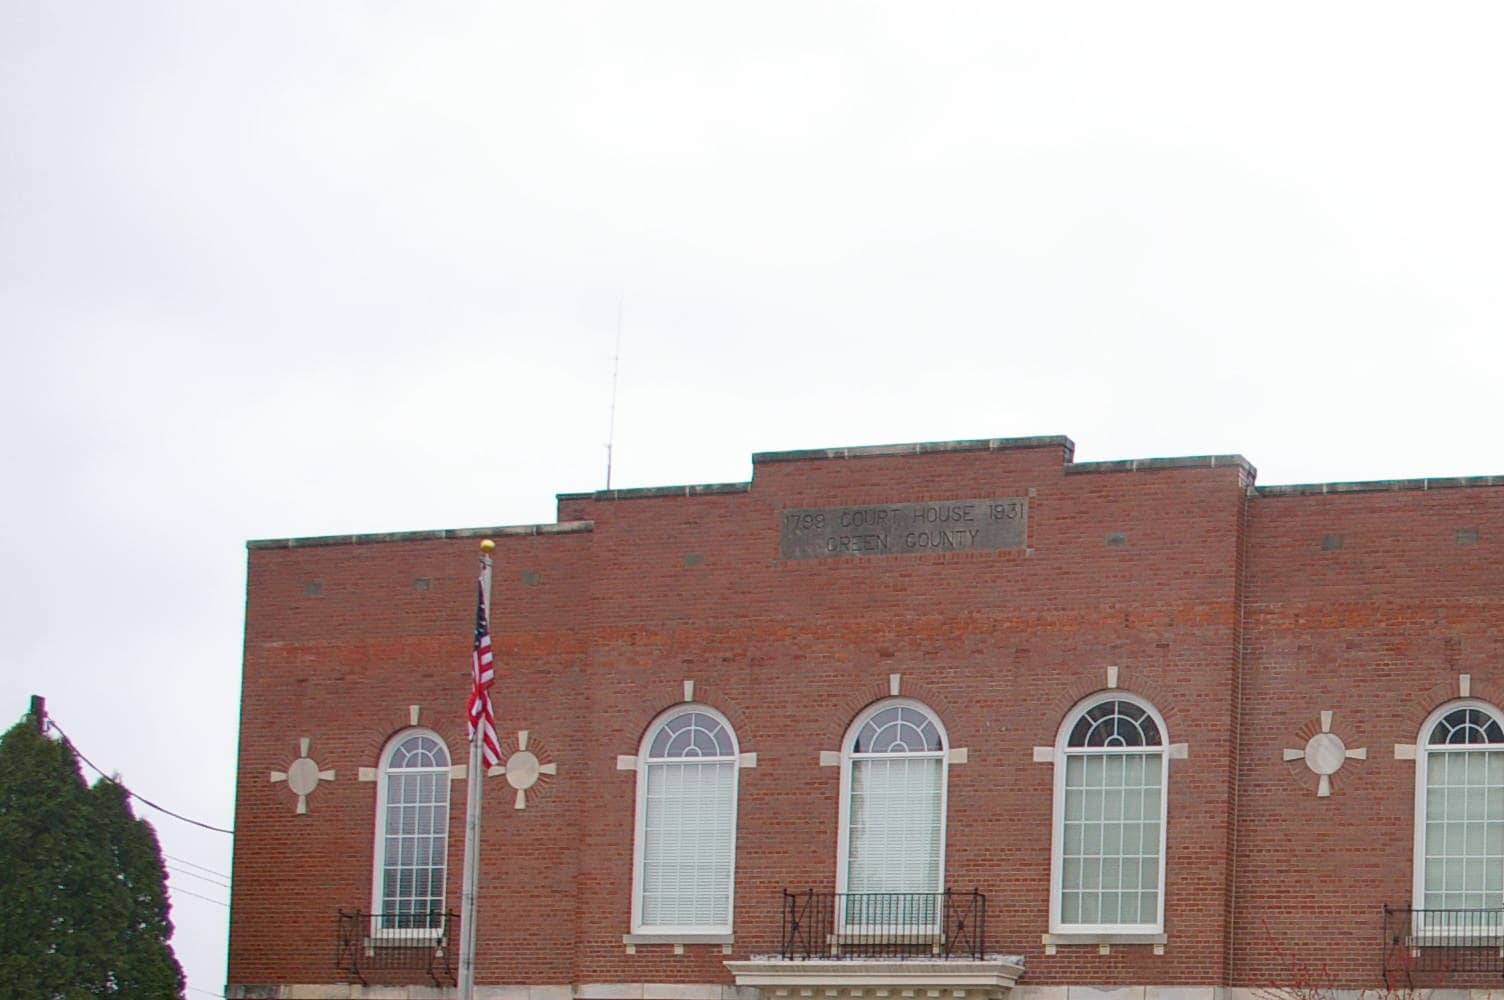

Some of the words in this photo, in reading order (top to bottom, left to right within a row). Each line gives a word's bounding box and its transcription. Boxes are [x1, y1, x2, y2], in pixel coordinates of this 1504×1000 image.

[840, 508, 901, 528] COURT
[912, 505, 976, 523] HOUSE
[988, 502, 1025, 520] 1931
[826, 534, 888, 552] GREEN
[905, 529, 980, 548] COUNTY
